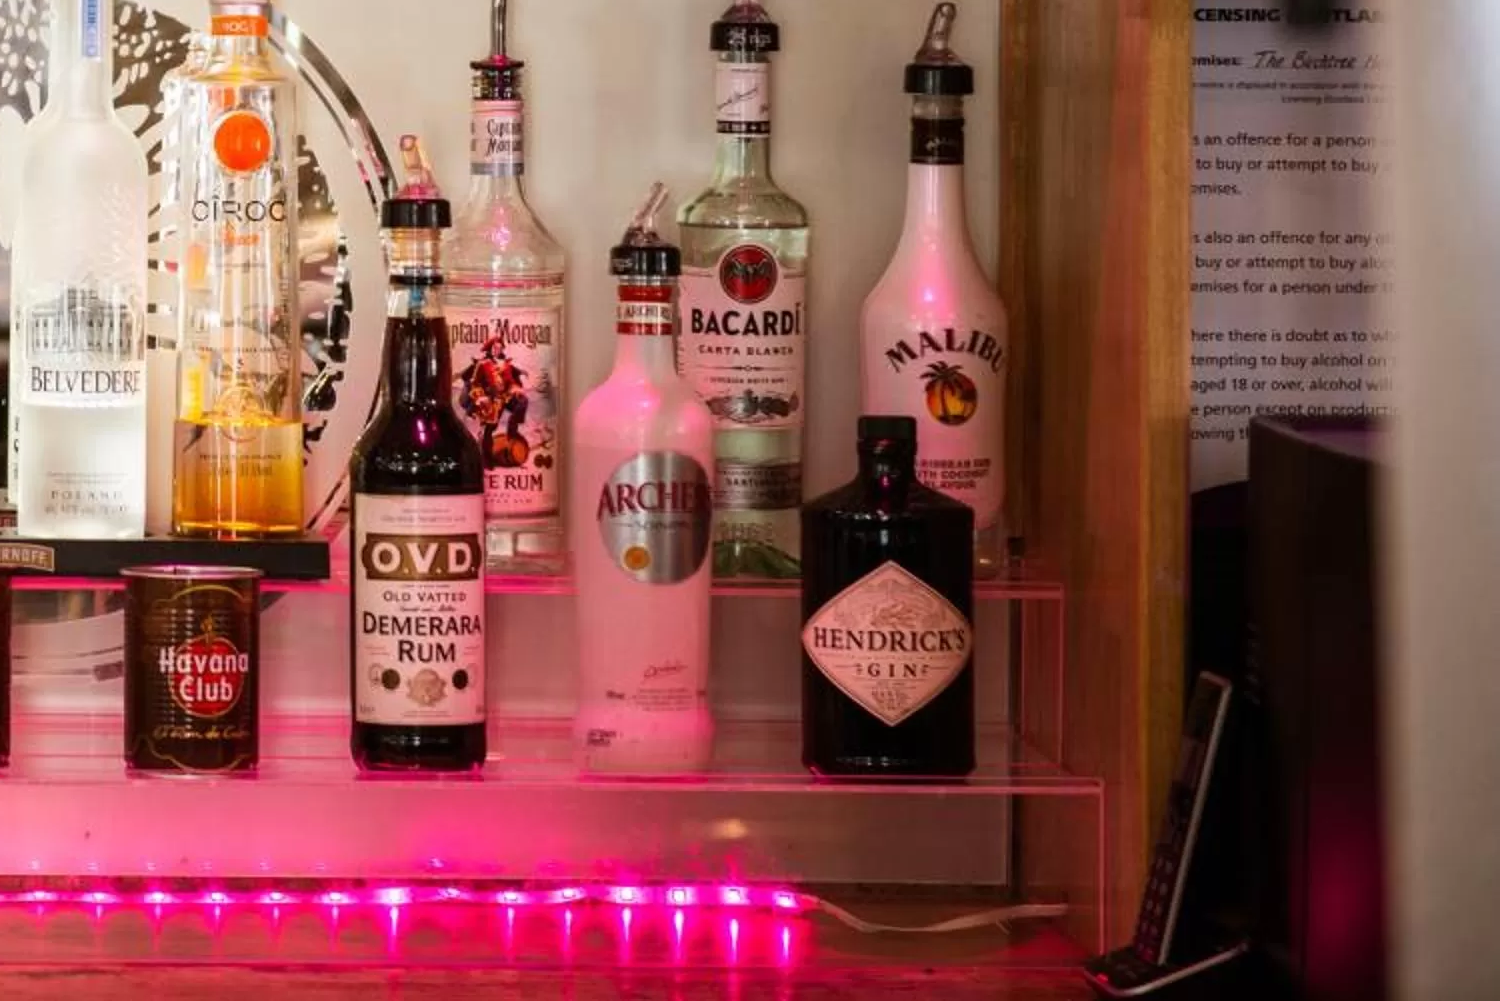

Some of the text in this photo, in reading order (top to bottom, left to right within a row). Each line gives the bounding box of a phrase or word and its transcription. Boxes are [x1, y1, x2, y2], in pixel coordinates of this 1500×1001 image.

[1193, 8, 1281, 23] CENSING
[1203, 135, 1222, 147] an
[1226, 131, 1282, 147] offence
[1286, 132, 1309, 147] for
[1327, 135, 1377, 151] person
[1195, 158, 1211, 170] to
[1215, 157, 1243, 173] buy
[1247, 160, 1263, 171] or
[1267, 158, 1327, 174] attempt
[1331, 159, 1348, 171] to
[1203, 230, 1371, 247] also an offence for any
[1195, 255, 1357, 271] buy or attempt to buy
[1243, 279, 1265, 293] for
[1281, 280, 1332, 296] person
[1335, 279, 1378, 294] under
[451, 319, 489, 348] ptain
[1191, 329, 1368, 343] here there is doubt as to
[699, 344, 741, 356] CARTA
[885, 327, 1008, 374] MALIBU
[1191, 353, 1258, 369] tempting
[1261, 355, 1277, 367] to
[1281, 353, 1308, 369] buy
[1311, 353, 1364, 367] alcohol
[30, 366, 141, 395] BELVEDERE
[1190, 378, 1226, 394] aged
[1231, 378, 1249, 391] 18
[1252, 381, 1266, 391] or
[1309, 377, 1362, 391] alcohol
[1202, 403, 1252, 418] person
[1307, 405, 1327, 416] on
[503, 473, 544, 492] RUM
[383, 589, 467, 604] OLD VATTED
[362, 610, 482, 637] DEMERARA
[813, 626, 966, 653] HENDRICK'S
[158, 645, 249, 674] Havana
[396, 639, 456, 663] RUM
[867, 662, 918, 679] GIN
[179, 674, 234, 702] Club
